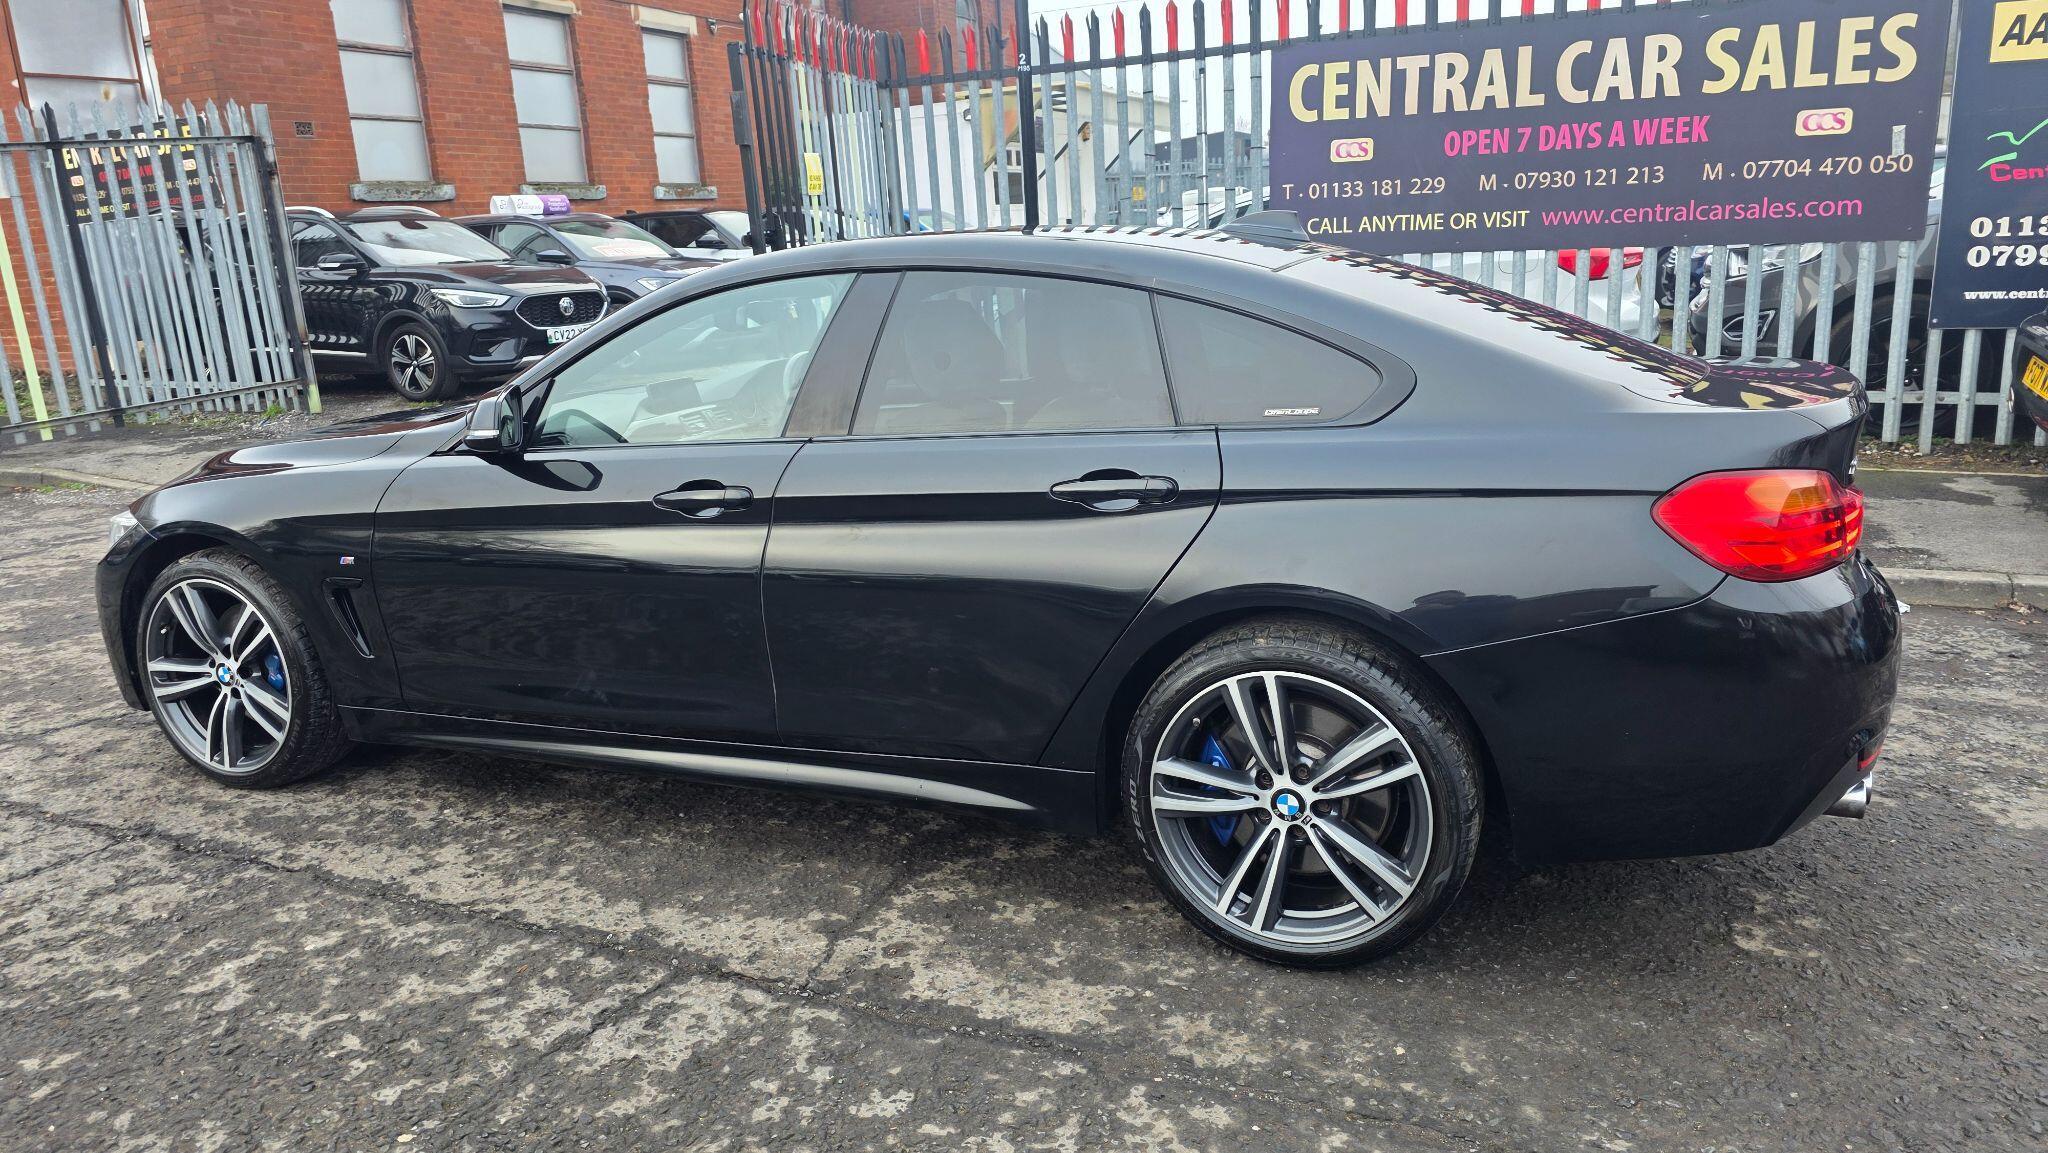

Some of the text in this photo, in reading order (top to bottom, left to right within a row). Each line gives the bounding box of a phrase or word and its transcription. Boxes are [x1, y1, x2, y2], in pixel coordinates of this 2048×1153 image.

[1018, 53, 1027, 65] 2
[1289, 12, 1919, 123] CENTRAL CAR SALES
[1444, 114, 1711, 157] OPEN 7 DAYS A WEEK
[1308, 180, 1364, 200] 01133
[1371, 179, 1401, 197] 181
[1408, 176, 1446, 196] 229
[1514, 169, 1576, 190] 07930
[1584, 167, 1617, 187] 121
[1626, 165, 1665, 185] 213
[1742, 158, 1813, 180] 07704
[1818, 156, 1863, 177] 470
[1869, 153, 1914, 174] 050
[1306, 197, 1863, 236] CALL ANYTIME OR VISIT www.centralcarsales.com
[1129, 777, 1147, 845] ZERO
